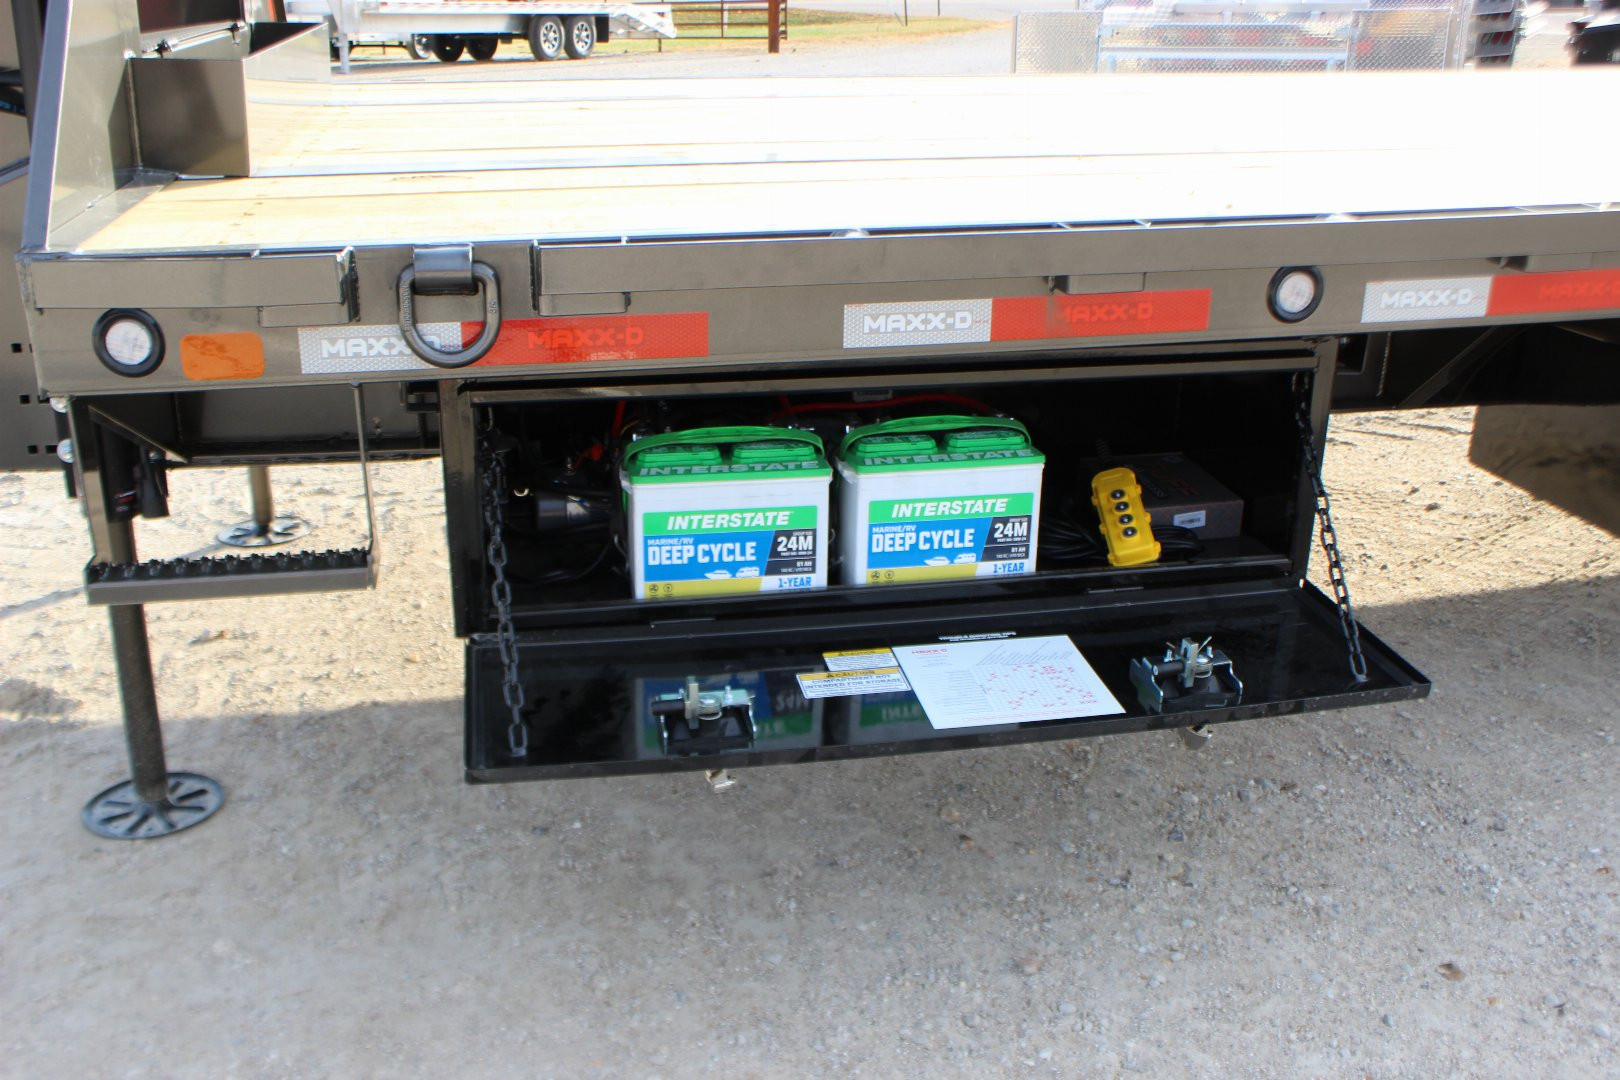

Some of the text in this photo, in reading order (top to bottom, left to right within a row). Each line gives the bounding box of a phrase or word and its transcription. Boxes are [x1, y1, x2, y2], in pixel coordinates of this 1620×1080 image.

[1380, 288, 1473, 309] MAXX-D
[863, 310, 973, 334] MAXX-D
[527, 325, 645, 349] MAXX-D
[864, 450, 1034, 466] INTERSTATE
[640, 461, 819, 476] INTERSTATE
[891, 498, 1008, 519] INTERSTATE
[667, 511, 791, 531] INTERSTATE
[872, 525, 917, 534] MARINE/RV
[994, 521, 1028, 539] 24M
[647, 537, 694, 546] MARINE/RV
[777, 535, 813, 552] 24M
[872, 528, 975, 553] DEEP CYCLE
[648, 541, 757, 566] DEEP CYCLE
[993, 562, 1024, 574] 1-YEAR
[778, 576, 812, 588] 1-YEAR
[812, 675, 873, 685] COMPARTMENT
[835, 670, 875, 678] CAUTION
[805, 681, 845, 689] INTENDED
